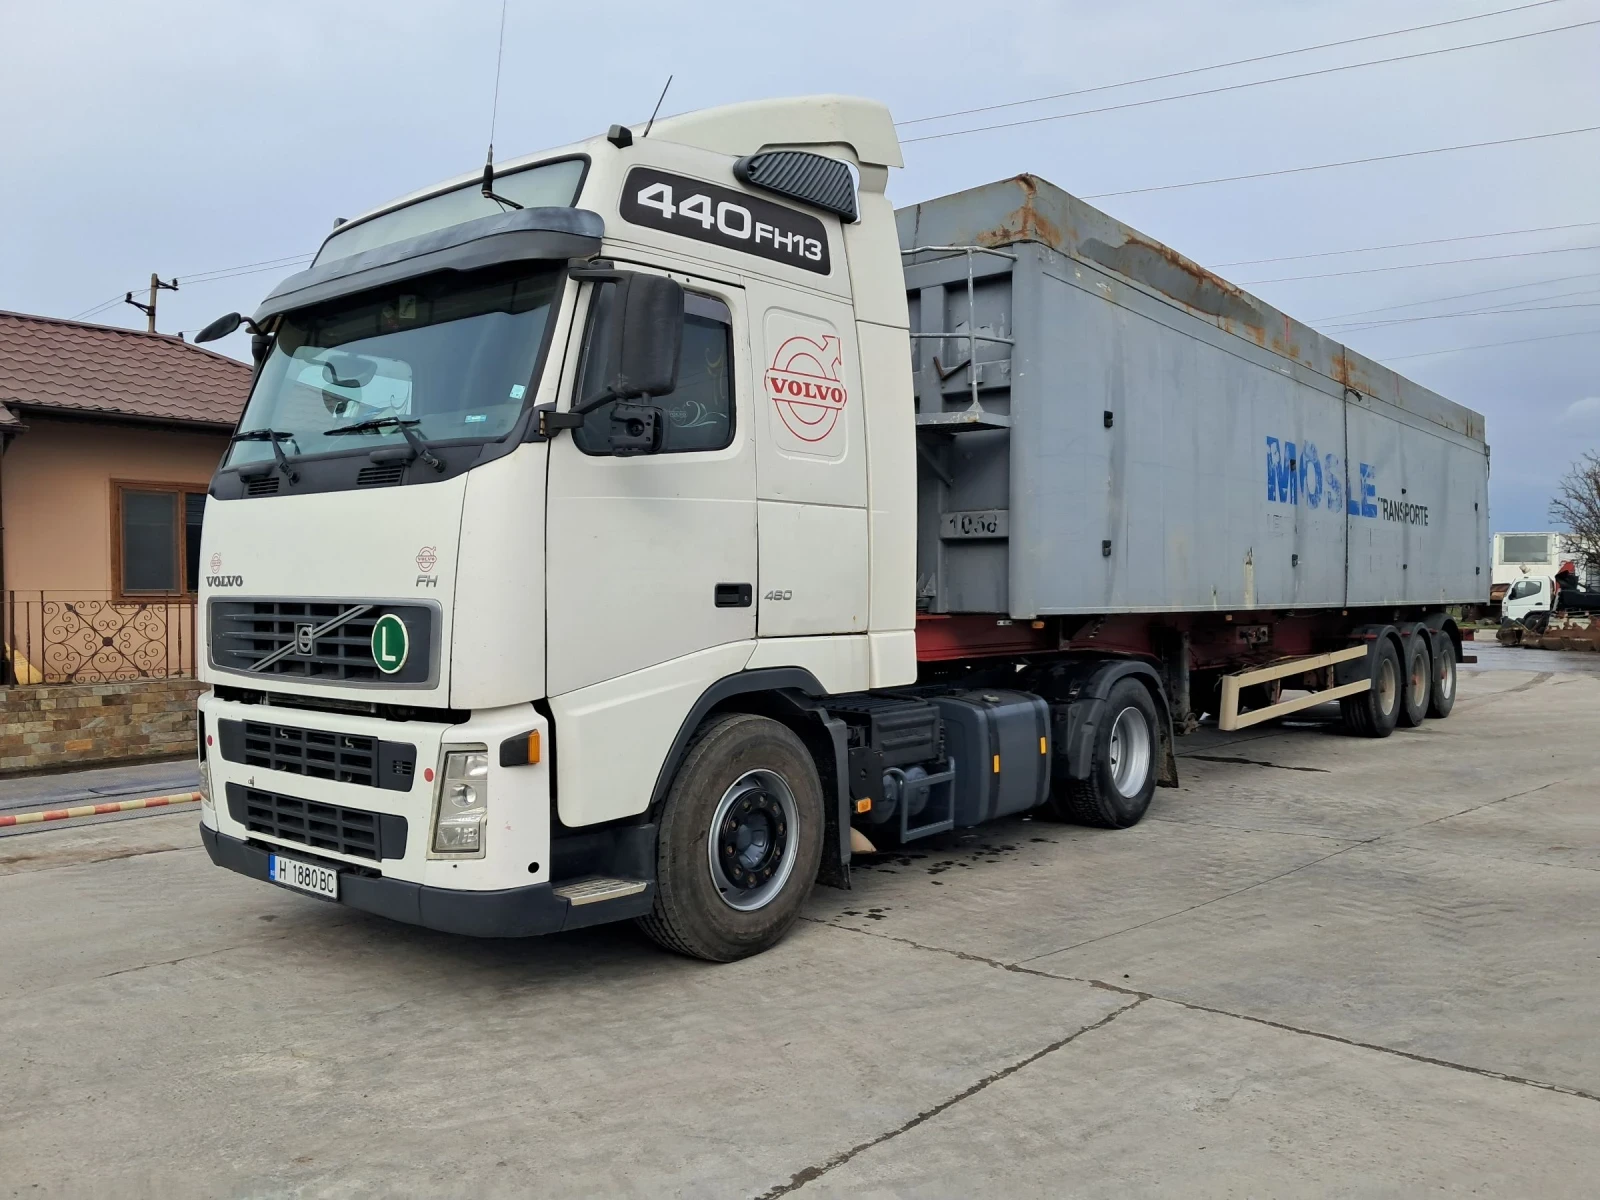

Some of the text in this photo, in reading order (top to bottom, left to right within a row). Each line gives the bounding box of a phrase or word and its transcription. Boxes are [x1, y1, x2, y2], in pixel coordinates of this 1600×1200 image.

[637, 182, 822, 261] 440 FH13
[770, 377, 843, 403] VOLVO
[206, 575, 243, 587] VOLVO
[416, 575, 438, 588] FH
[381, 626, 396, 662] L
